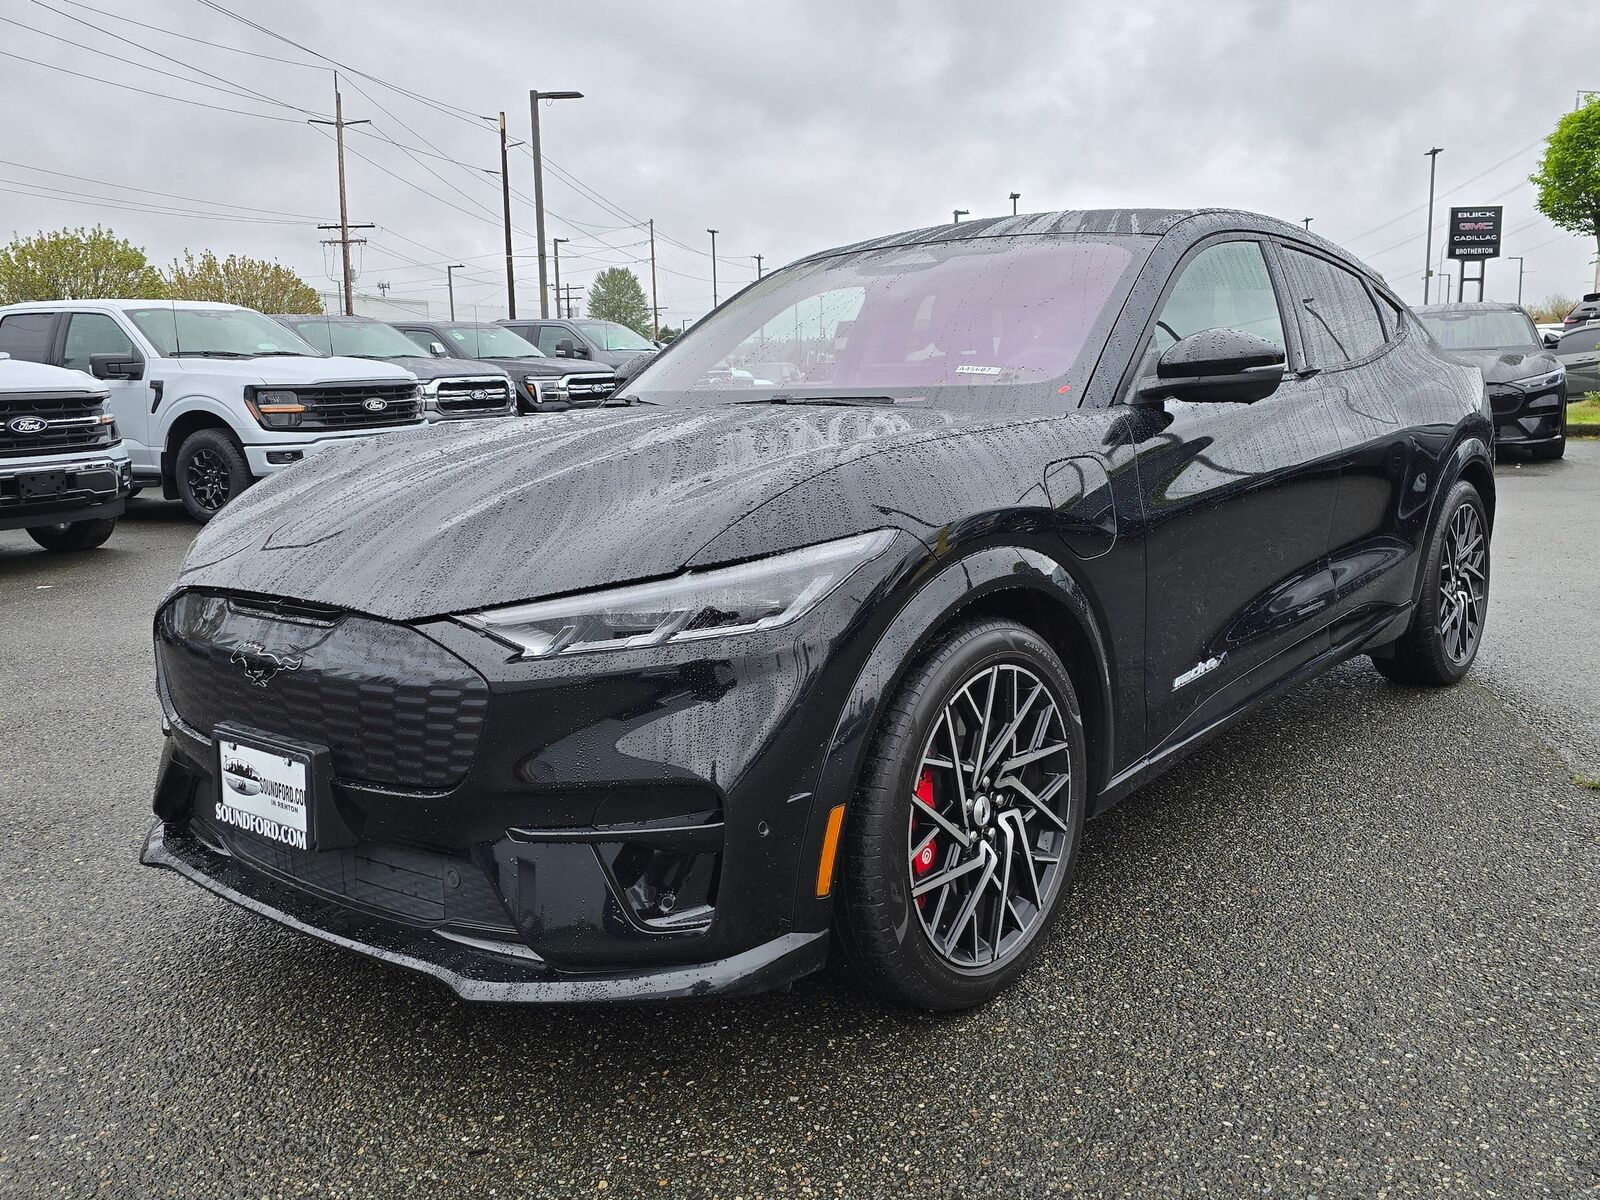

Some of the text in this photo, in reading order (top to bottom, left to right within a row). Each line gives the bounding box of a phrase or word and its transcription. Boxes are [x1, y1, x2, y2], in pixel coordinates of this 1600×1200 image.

[1459, 222, 1493, 230] GMC
[1455, 247, 1493, 255] BROTHERTON
[17, 419, 42, 431] Ford
[260, 777, 306, 806] SOUNDFORD.CO
[277, 801, 299, 813] RENTON
[215, 801, 307, 850] SOUNDFORD.COM
